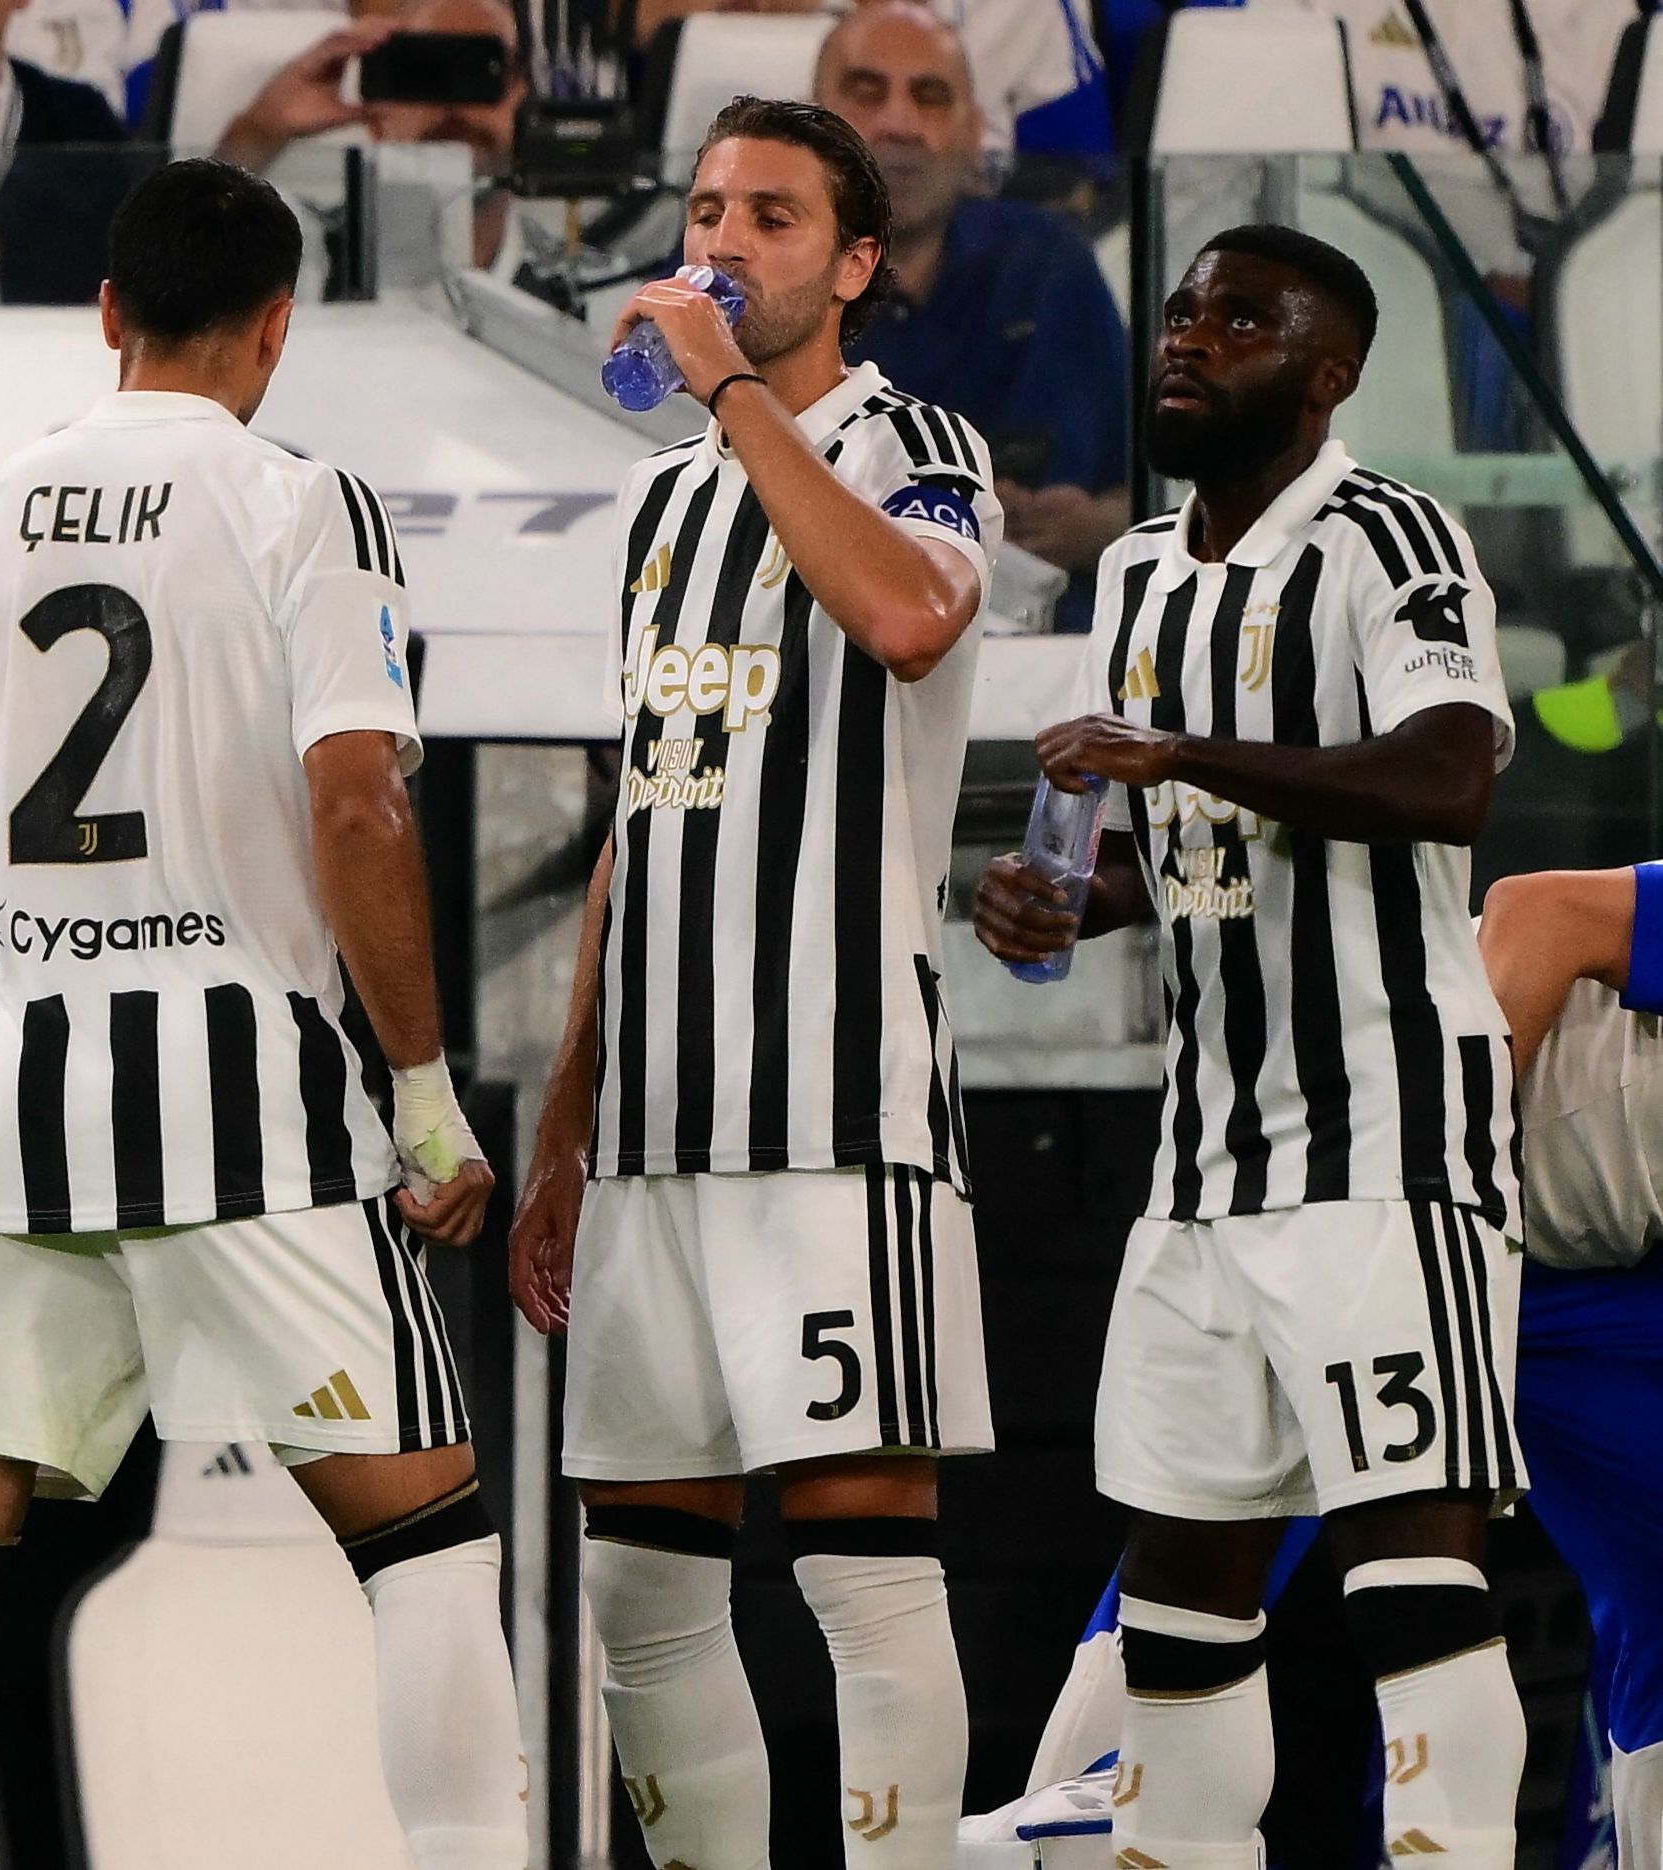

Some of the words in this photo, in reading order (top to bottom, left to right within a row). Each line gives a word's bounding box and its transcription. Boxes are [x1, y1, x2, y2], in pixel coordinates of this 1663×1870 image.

[20, 482, 173, 553] ÇELIK
[9, 583, 153, 864] 2
[624, 624, 781, 733] Jeep
[626, 766, 725, 821] Detroit
[647, 737, 704, 772] VISIT
[10, 910, 226, 962] Cygames
[802, 1309, 861, 1421] 5
[1325, 1351, 1437, 1474] 13
